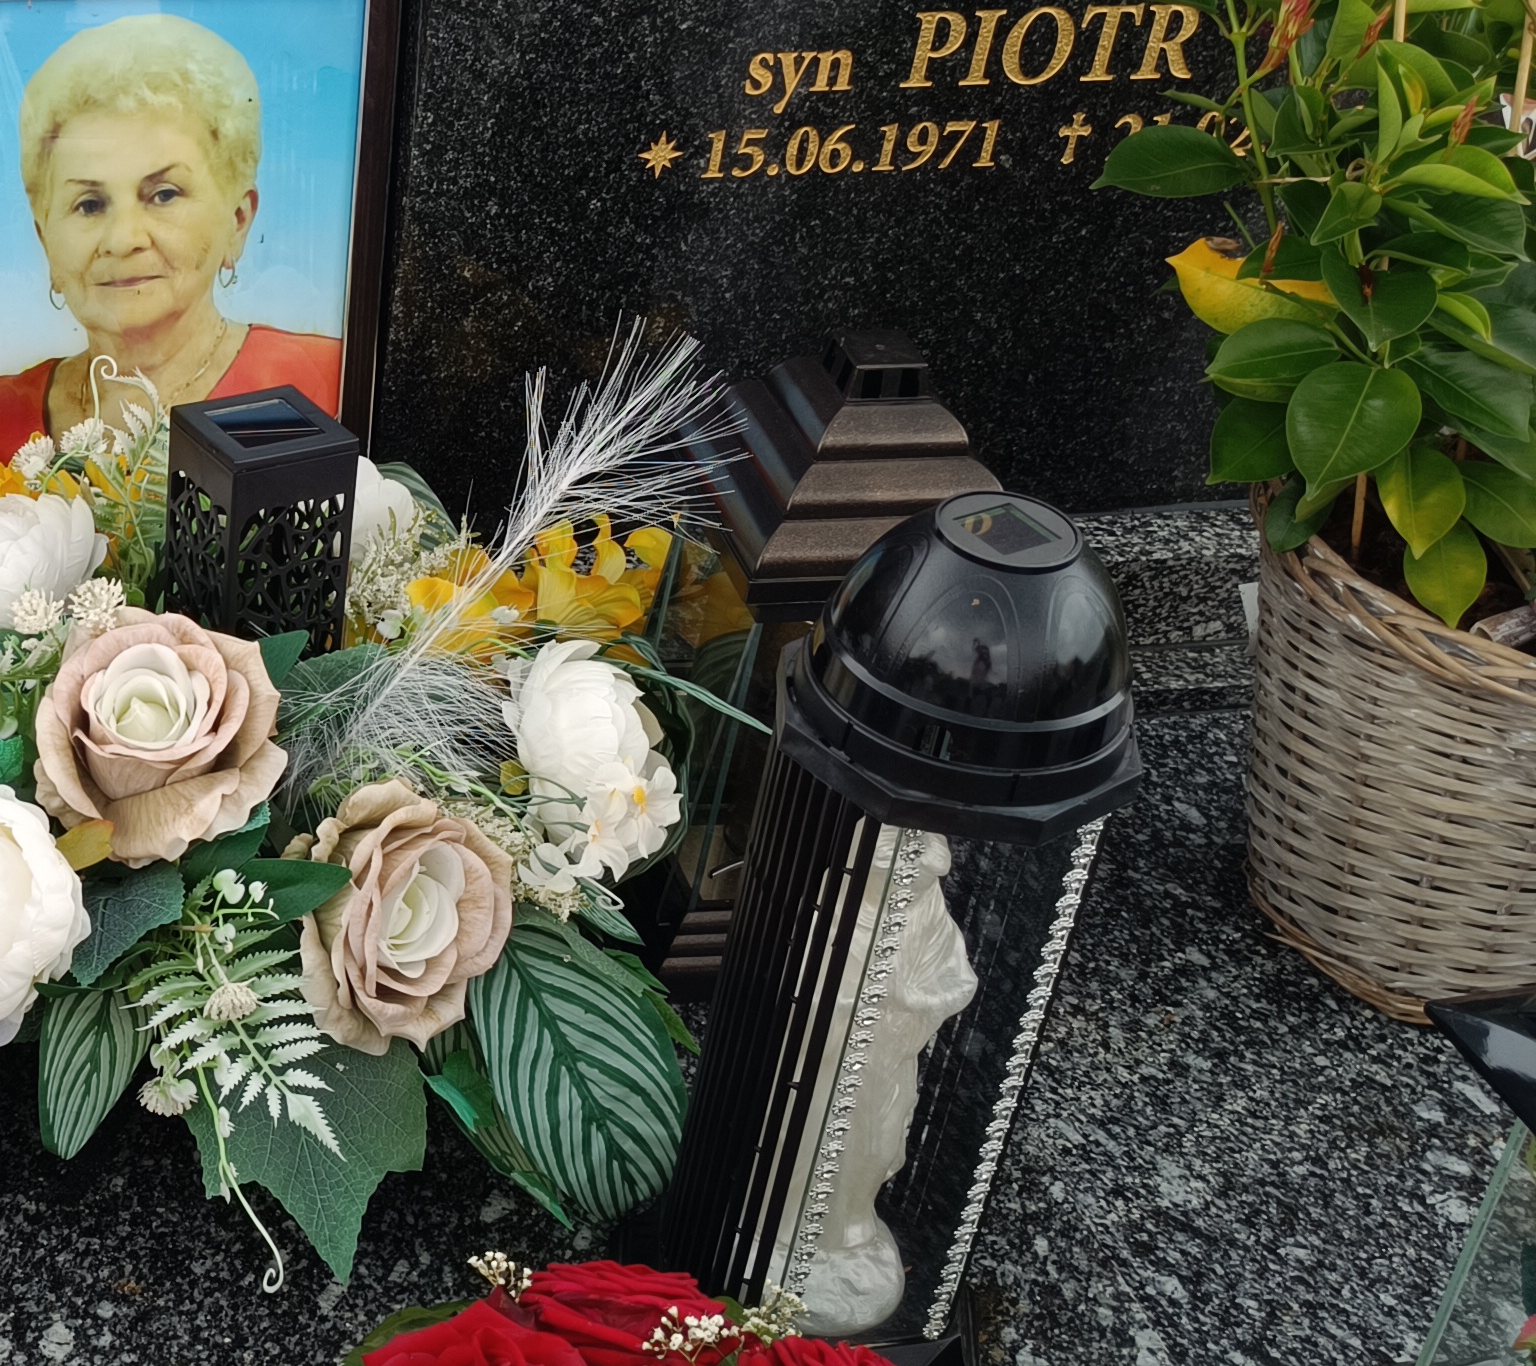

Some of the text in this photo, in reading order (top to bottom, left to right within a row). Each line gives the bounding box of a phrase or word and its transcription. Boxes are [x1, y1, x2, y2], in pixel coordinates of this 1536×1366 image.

[743, 2, 1200, 115] syn PIOTR
[699, 119, 1001, 180] 15.06.1971
